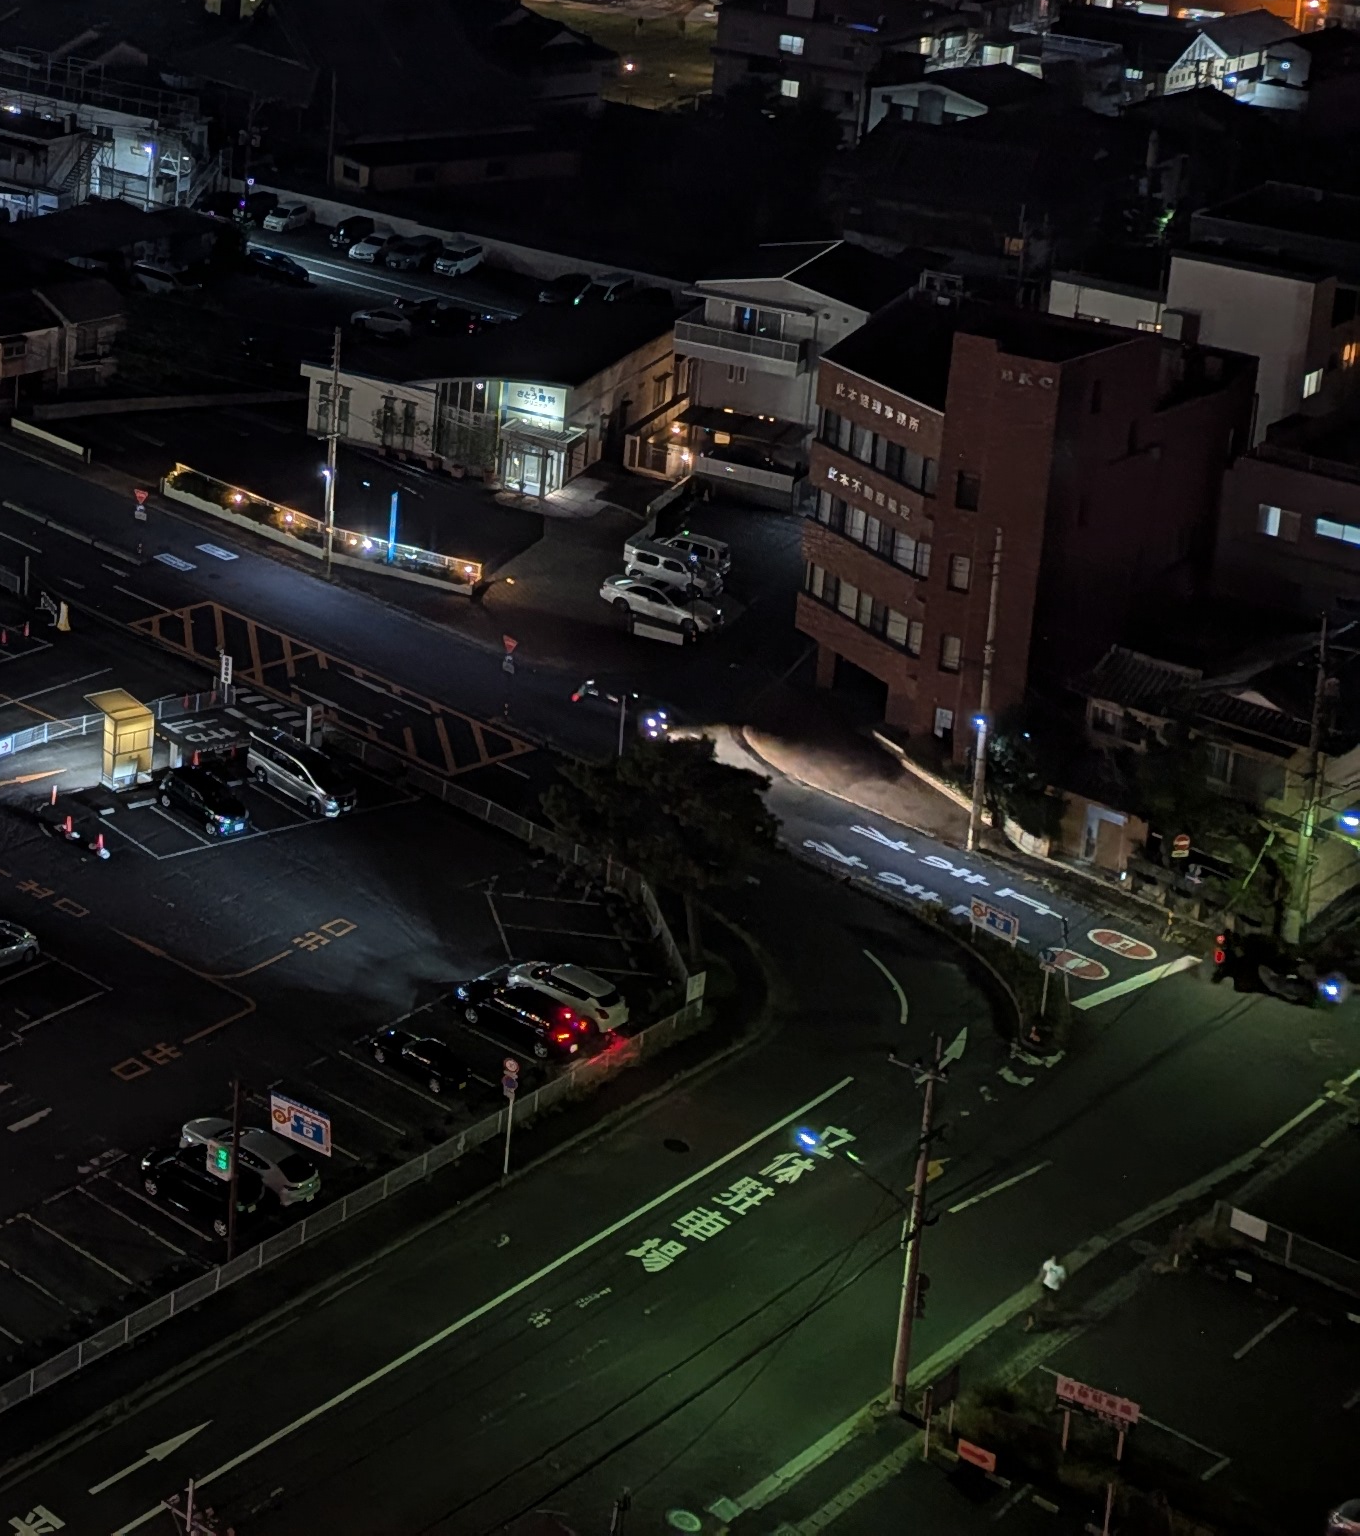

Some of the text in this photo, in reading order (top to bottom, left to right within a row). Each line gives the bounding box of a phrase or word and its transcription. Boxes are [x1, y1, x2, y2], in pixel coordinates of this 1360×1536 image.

[850, 824, 1068, 920] 止まれ
[292, 918, 358, 952] 出口
